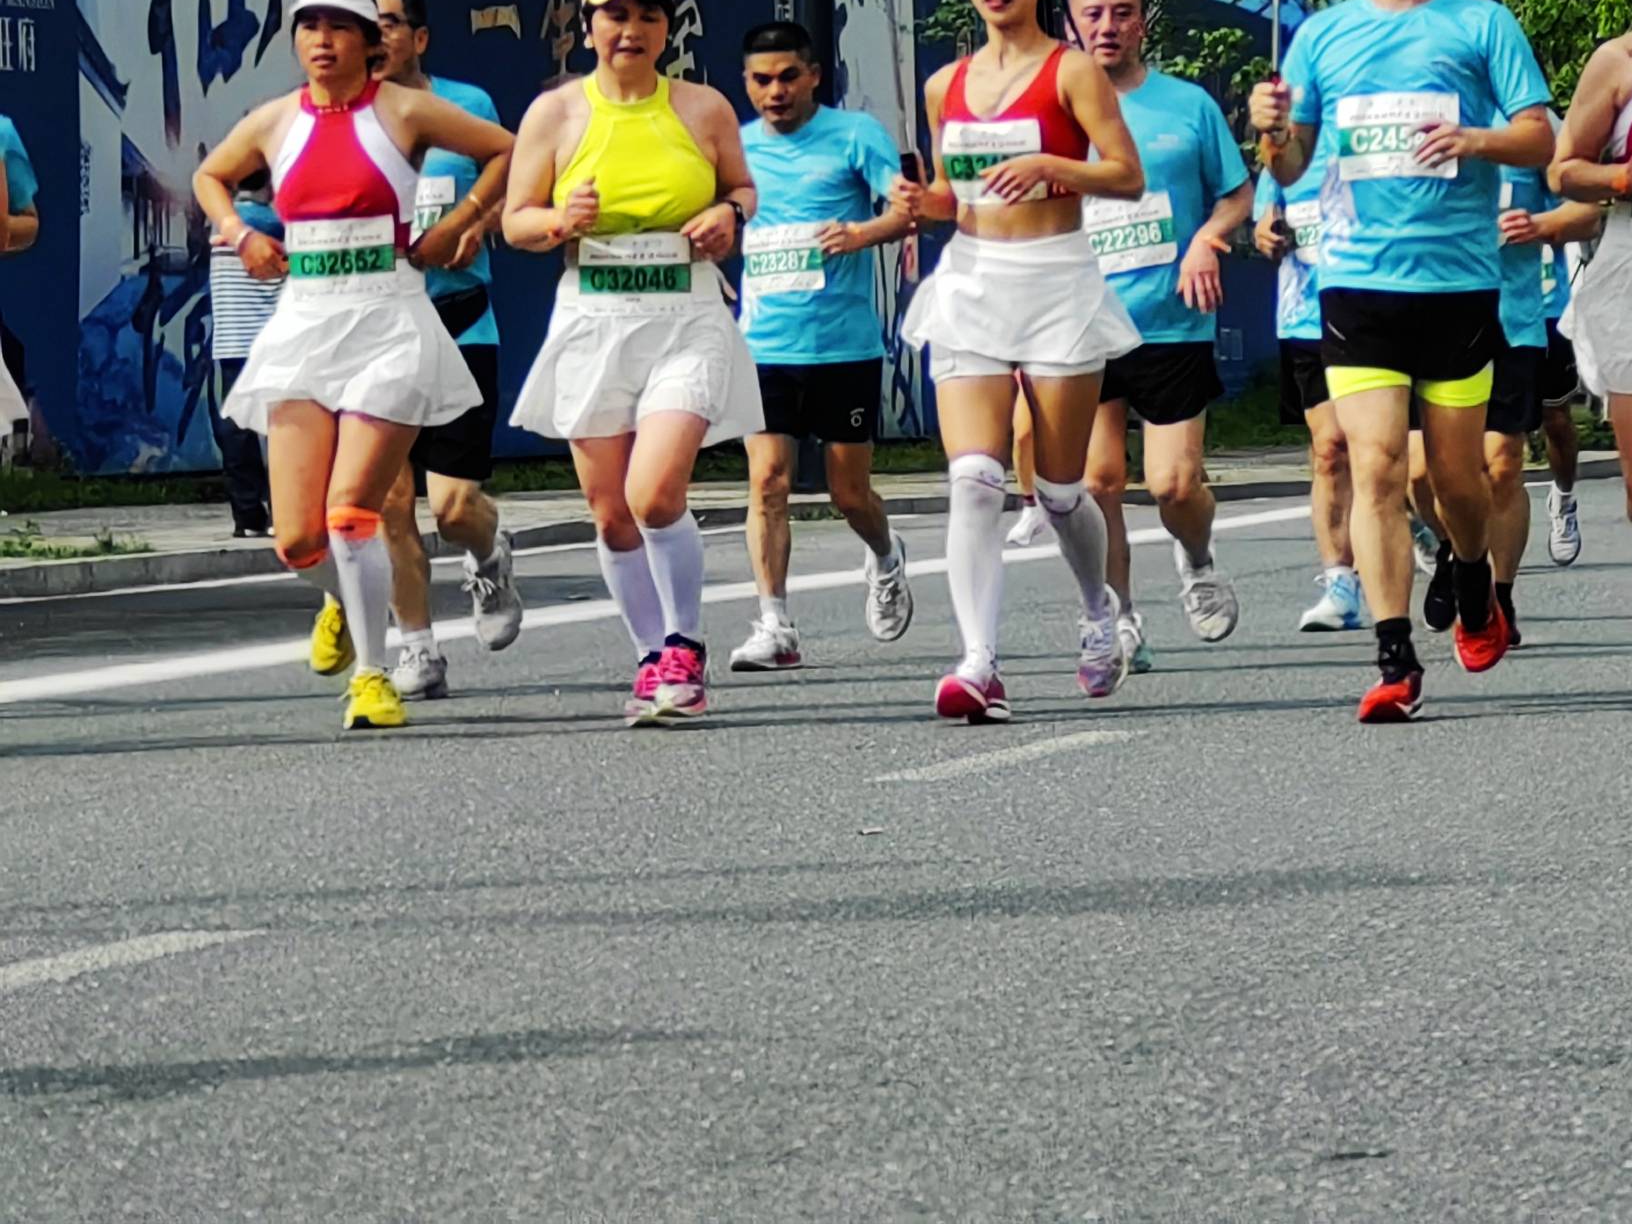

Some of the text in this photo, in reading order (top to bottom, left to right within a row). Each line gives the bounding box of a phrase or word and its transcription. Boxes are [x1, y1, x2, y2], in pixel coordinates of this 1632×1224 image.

[1088, 221, 1162, 255] C22296
[750, 249, 811, 275] C23287
[590, 265, 678, 292] C32046
